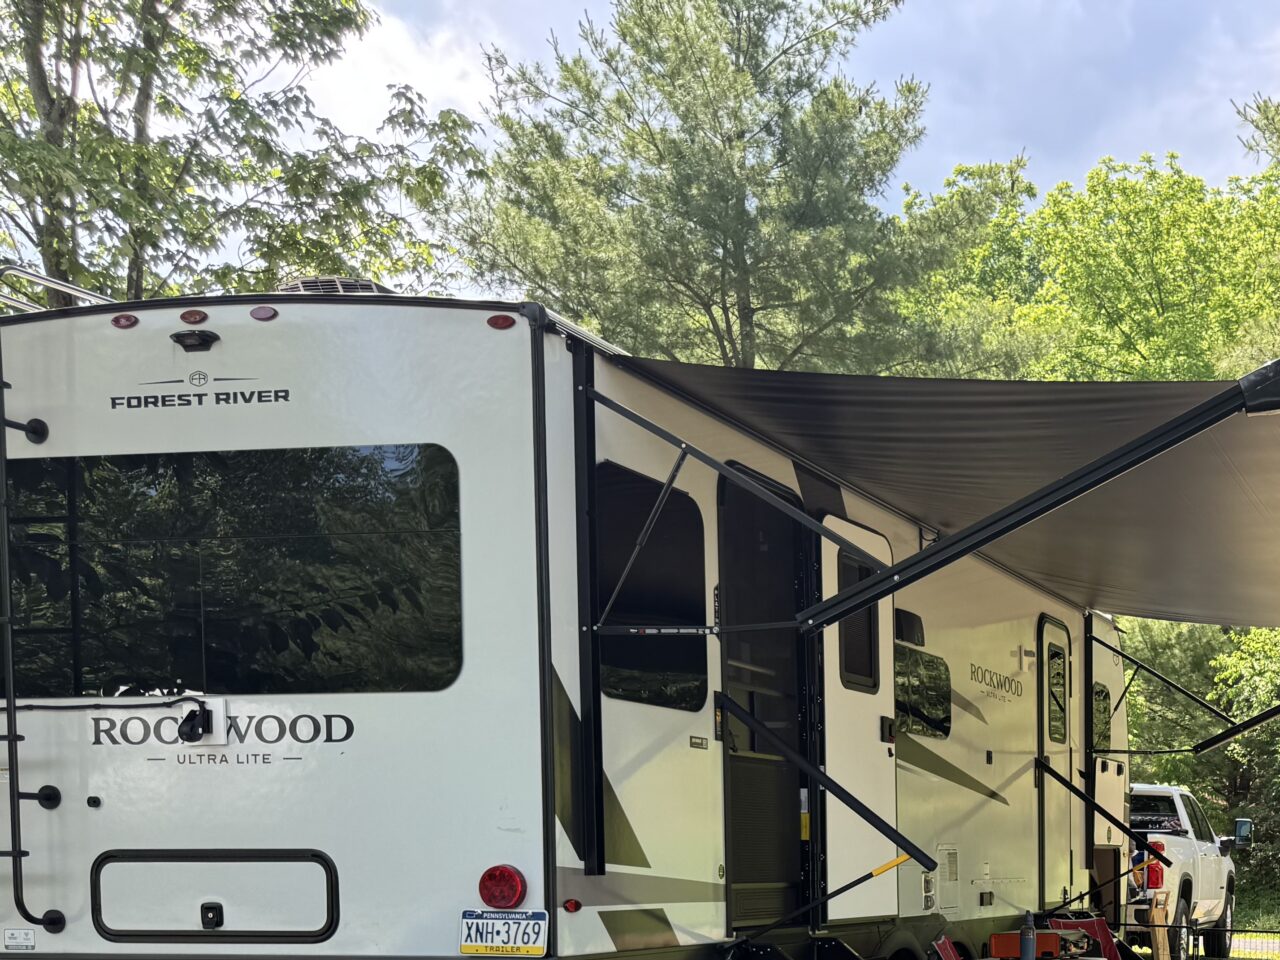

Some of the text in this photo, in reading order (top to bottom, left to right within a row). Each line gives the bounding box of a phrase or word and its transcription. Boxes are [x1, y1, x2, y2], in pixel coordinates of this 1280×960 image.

[110, 389, 290, 409] FOREST RIVER
[970, 663, 1023, 697] ROCKWOOD
[91, 714, 355, 745] ROCWOOD
[177, 753, 272, 765] ULTRA LITE
[484, 945, 521, 953] TRAILER
